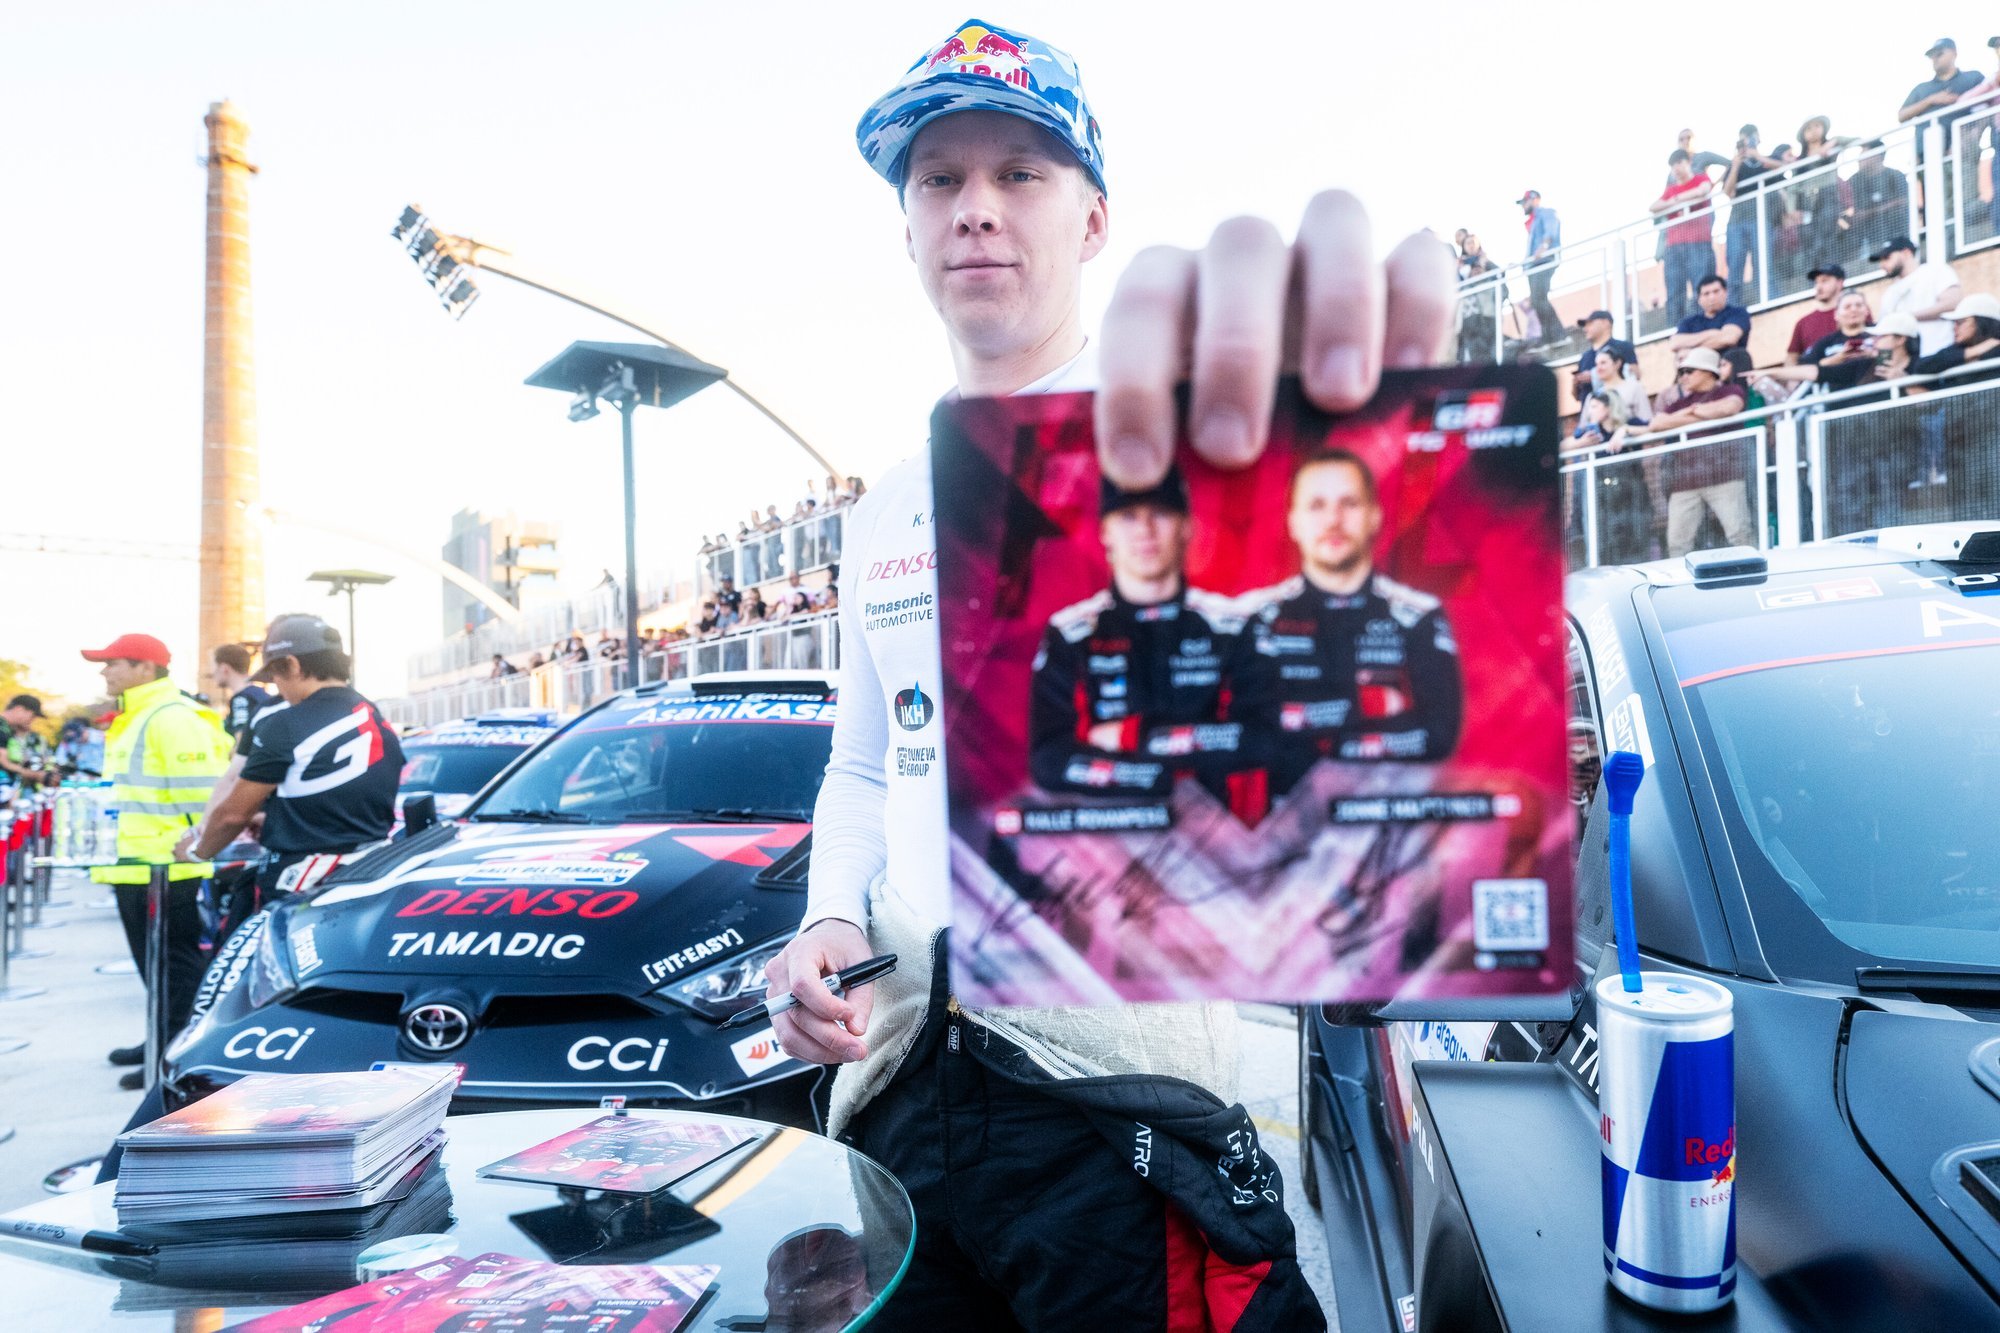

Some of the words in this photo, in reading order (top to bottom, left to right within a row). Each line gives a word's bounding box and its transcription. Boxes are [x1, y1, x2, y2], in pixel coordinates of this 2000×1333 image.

[865, 592, 933, 617] Panasonic
[866, 608, 934, 632] AUTOMOTIVE
[907, 762, 930, 777] GROUP
[395, 888, 639, 919] DENSO
[388, 931, 586, 960] TAMADIC
[950, 1025, 958, 1050] OMP
[1685, 1126, 1733, 1166] Red
